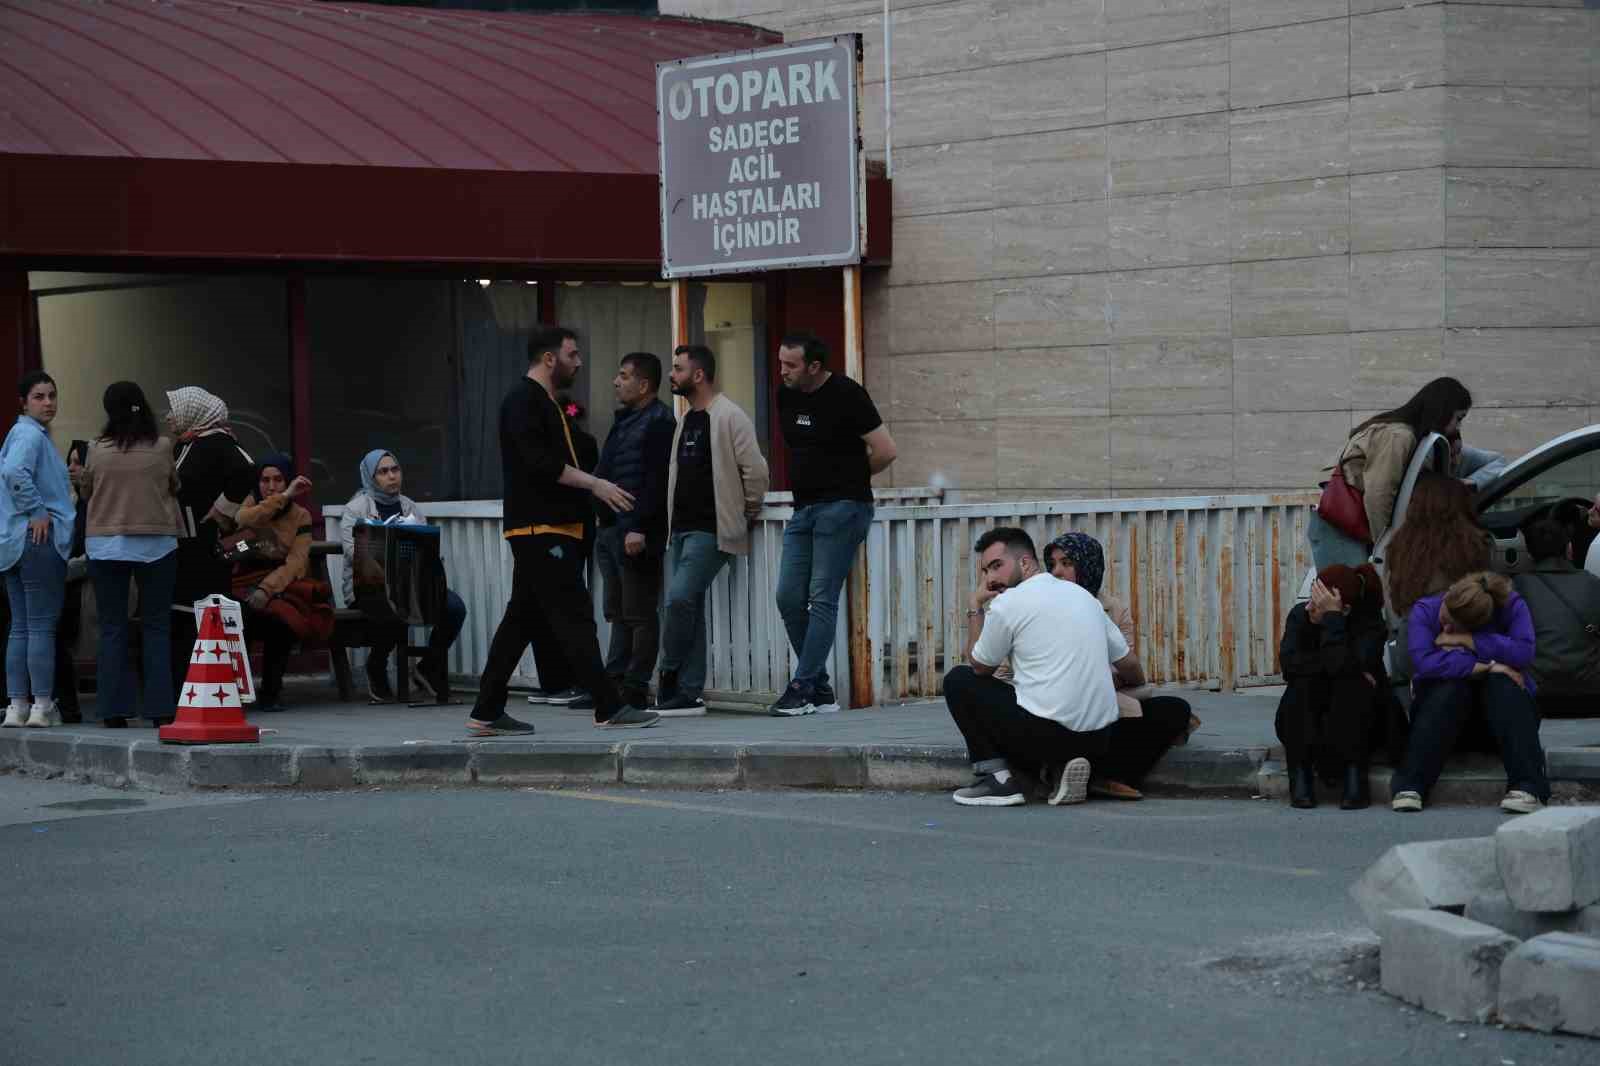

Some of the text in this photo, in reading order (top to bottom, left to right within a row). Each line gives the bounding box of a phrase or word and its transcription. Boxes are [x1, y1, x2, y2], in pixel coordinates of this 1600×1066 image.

[668, 59, 841, 120] OTOPARK
[709, 116, 800, 152] SADECE
[728, 147, 781, 183] ACİL
[692, 182, 821, 220] HASTALARI
[713, 213, 801, 256] İÇİNDİR
